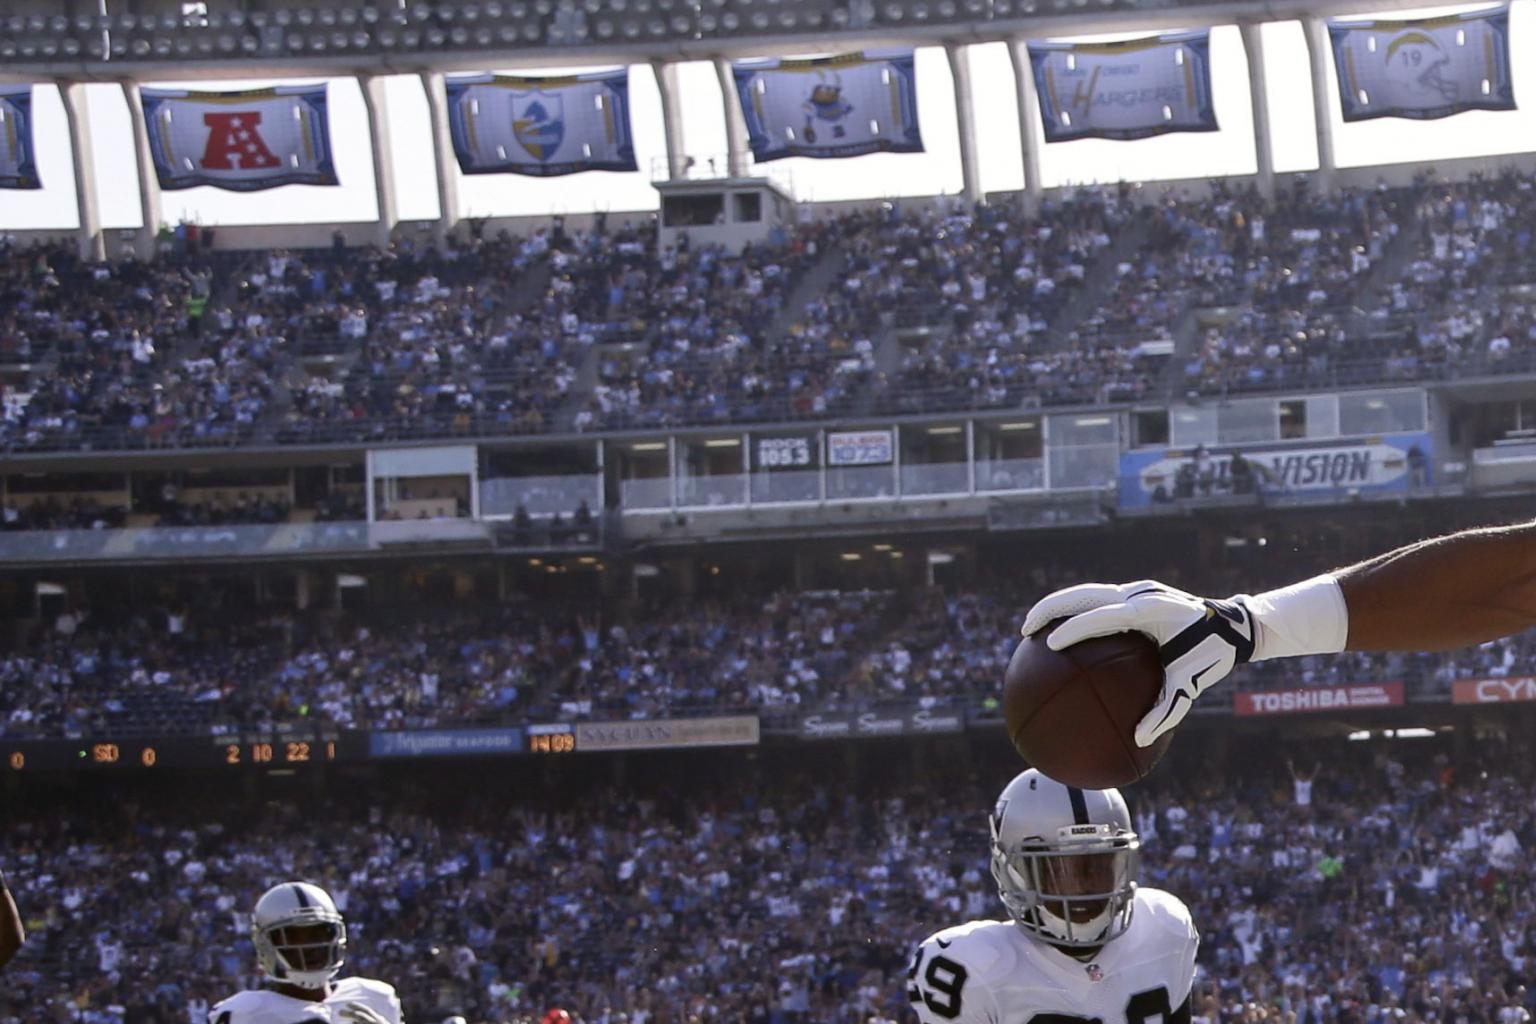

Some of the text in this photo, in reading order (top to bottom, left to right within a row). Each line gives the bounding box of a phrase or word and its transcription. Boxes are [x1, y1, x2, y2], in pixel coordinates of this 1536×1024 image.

[1402, 50, 1422, 66] 19
[1251, 689, 1349, 712] TOSHIBA
[10, 752, 24, 769] 0
[93, 744, 119, 762] SD
[142, 748, 156, 766] 0
[226, 744, 240, 763] 2
[252, 743, 273, 762] 10
[286, 742, 310, 761] 22
